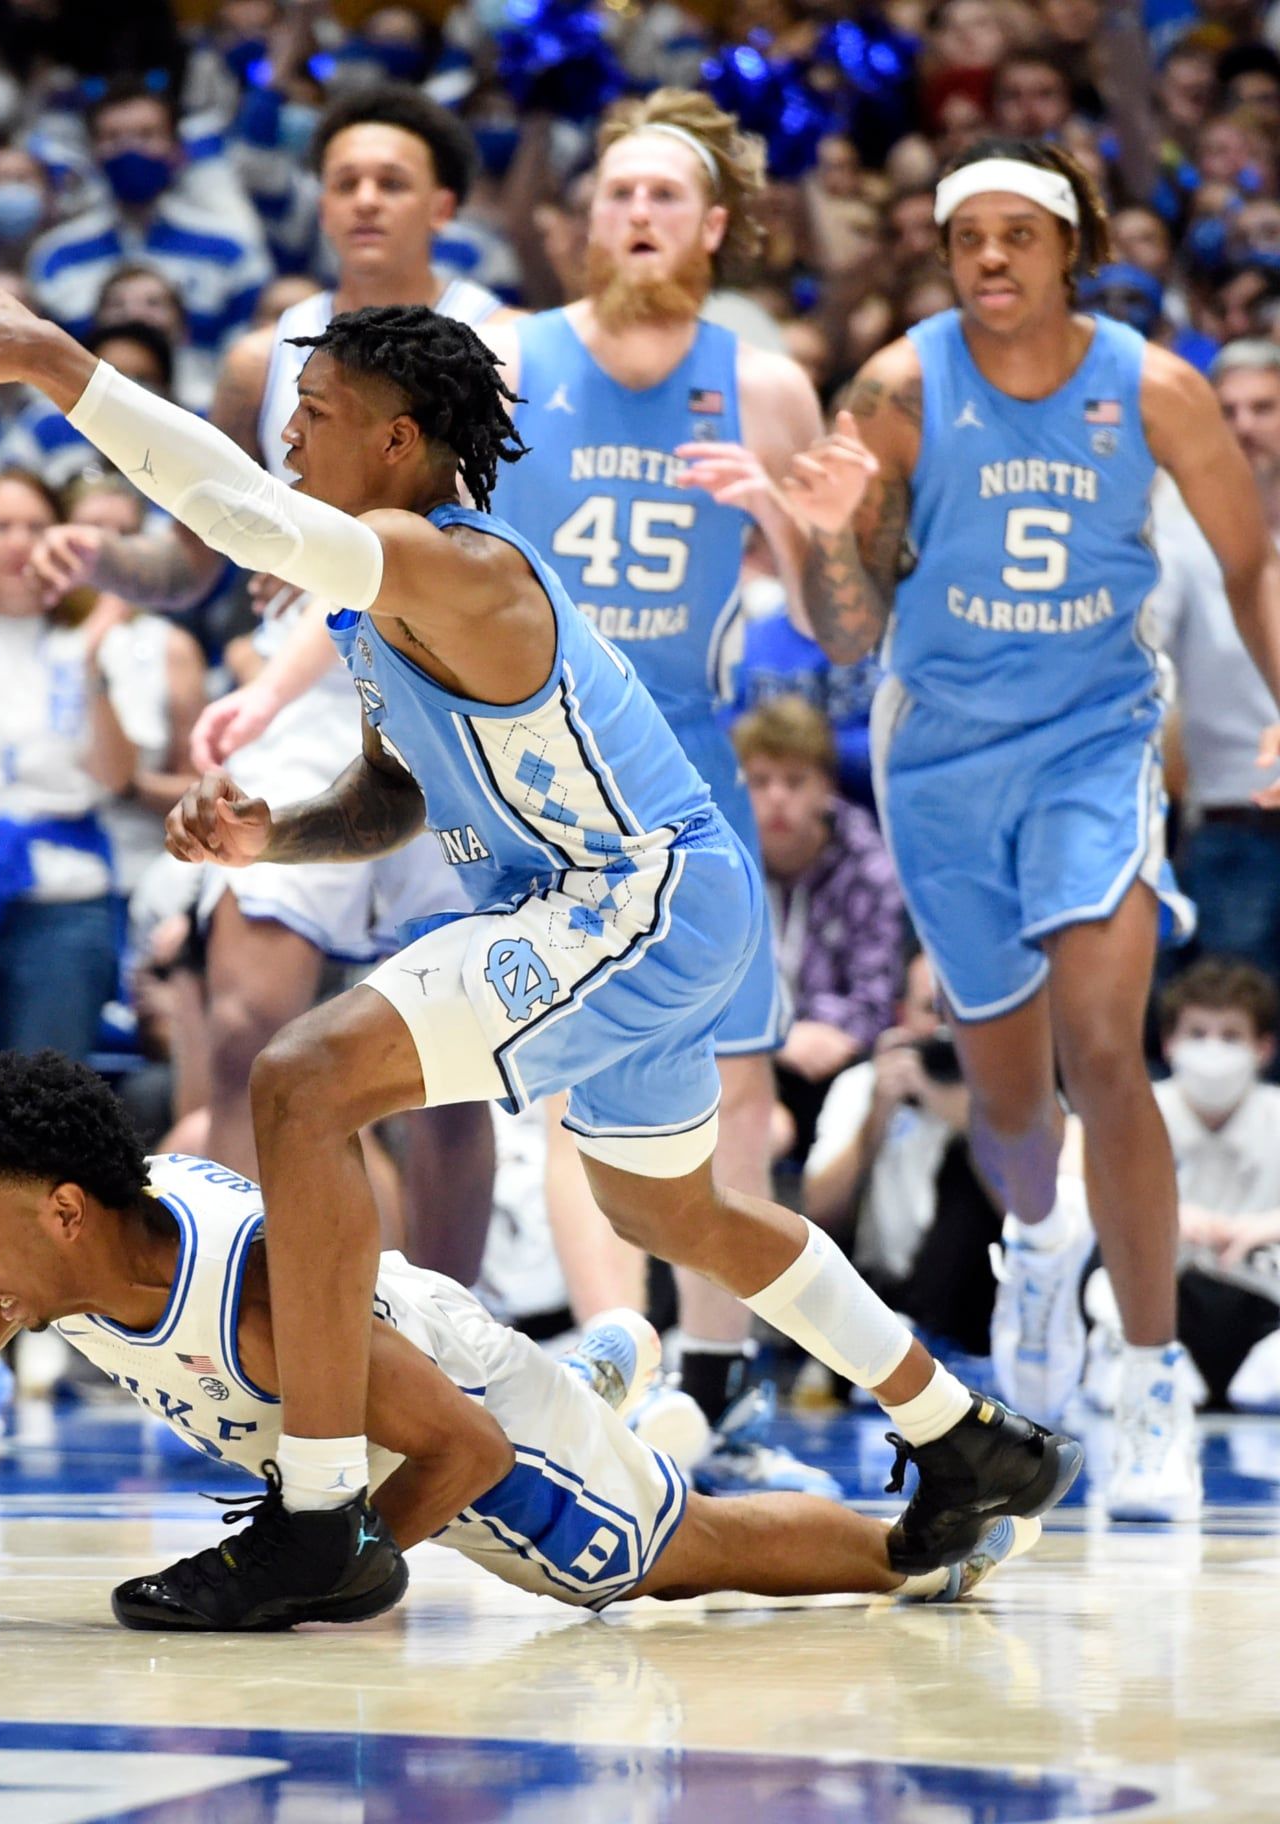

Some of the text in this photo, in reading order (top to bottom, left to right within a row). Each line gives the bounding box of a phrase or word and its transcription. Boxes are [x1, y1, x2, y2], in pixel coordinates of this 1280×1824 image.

[570, 444, 689, 490] NORTH
[978, 457, 1100, 504] NORTH
[551, 493, 697, 593] 45
[1000, 506, 1072, 593] 5
[945, 583, 1115, 635] CAROLINA
